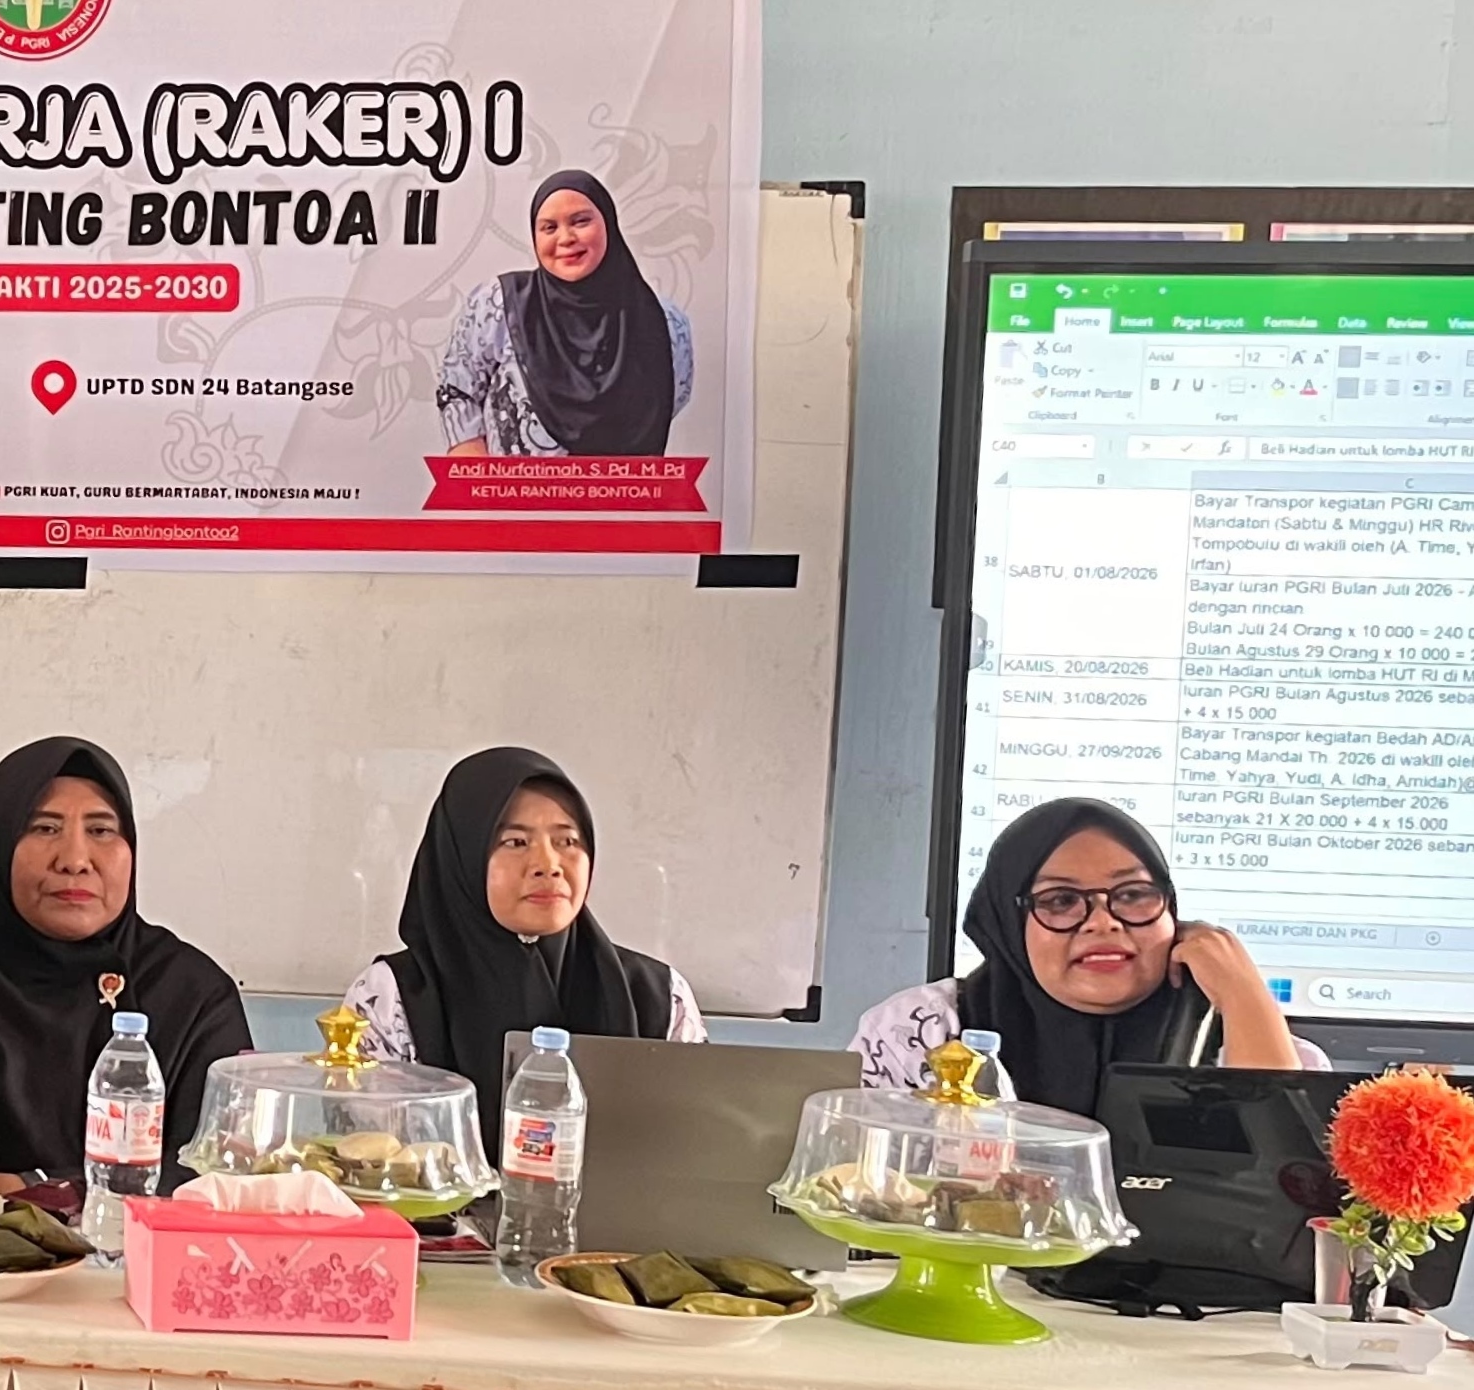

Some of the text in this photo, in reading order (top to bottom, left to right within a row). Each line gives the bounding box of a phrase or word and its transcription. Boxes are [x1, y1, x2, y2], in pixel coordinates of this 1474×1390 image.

[21, 37, 50, 49] PGRI
[143, 82, 471, 184] (RAKER)
[486, 81, 523, 166] I
[128, 191, 377, 246] BONTOA
[403, 189, 438, 245] II
[69, 274, 229, 300] 2025-2030
[1065, 317, 1100, 327] Home
[1120, 316, 1153, 327] Insert
[1172, 316, 1201, 329] Page
[1205, 316, 1244, 330] Layout
[1338, 317, 1367, 328] Data
[1387, 318, 1428, 328] Review
[1053, 343, 1072, 354] Cut
[1148, 352, 1174, 361] Arial
[1051, 365, 1082, 378] Copy
[87, 378, 354, 400] UPTD SDN 24 Batangase
[1050, 388, 1090, 398] Format
[449, 462, 485, 478] Andi
[664, 463, 685, 478] Pd
[4, 486, 351, 500] PGRI KUAT, GURU BERMARTABAT, INDONESIA MAJU
[472, 486, 661, 498] KETUA RANTING BONTOA II
[1194, 494, 1433, 512] Bayar Transpor kegiatan PGRI
[1419, 519, 1443, 531] HR
[1074, 566, 1158, 580] 01/08/2026
[1190, 579, 1453, 596] Bayar PGRI Bulan Juli 2026
[1188, 601, 1247, 617] dengan
[1187, 621, 1342, 640] Bulan Juli 24 Orang
[1186, 642, 1378, 661] Bulan Agustus 29 Orang
[1065, 660, 1149, 675] 20/08/2026
[1279, 666, 1322, 679] untuk
[1382, 668, 1416, 681] HUT
[1064, 692, 1147, 707] 31/08/2026
[1229, 686, 1270, 698] PGRI
[1276, 686, 1320, 700] Bulan
[1326, 688, 1390, 704] Agustus
[1395, 689, 1433, 703] 2026
[1181, 727, 1427, 745] Bayar Transpor kegiatan Bedah
[1078, 745, 1162, 759] 27/09/2026
[1180, 748, 1241, 764] Cabang
[1338, 752, 1376, 765] 2026
[1223, 790, 1263, 804] PGRI
[1270, 792, 1314, 805] Bulan
[1320, 793, 1405, 809] September
[1410, 796, 1449, 809] 2026
[1177, 812, 1249, 827] sebanyak
[1256, 813, 1272, 826] 21
[1220, 832, 1261, 845] PGRI
[1268, 833, 1312, 847] Bulan
[1318, 835, 1380, 850] Oktober
[1385, 838, 1422, 851] 2026
[1283, 925, 1313, 937] PGRI
[1317, 927, 1346, 939] DAN
[1351, 928, 1378, 940] PKG
[1346, 986, 1392, 1000] Search
[1121, 1175, 1173, 1191] acer
